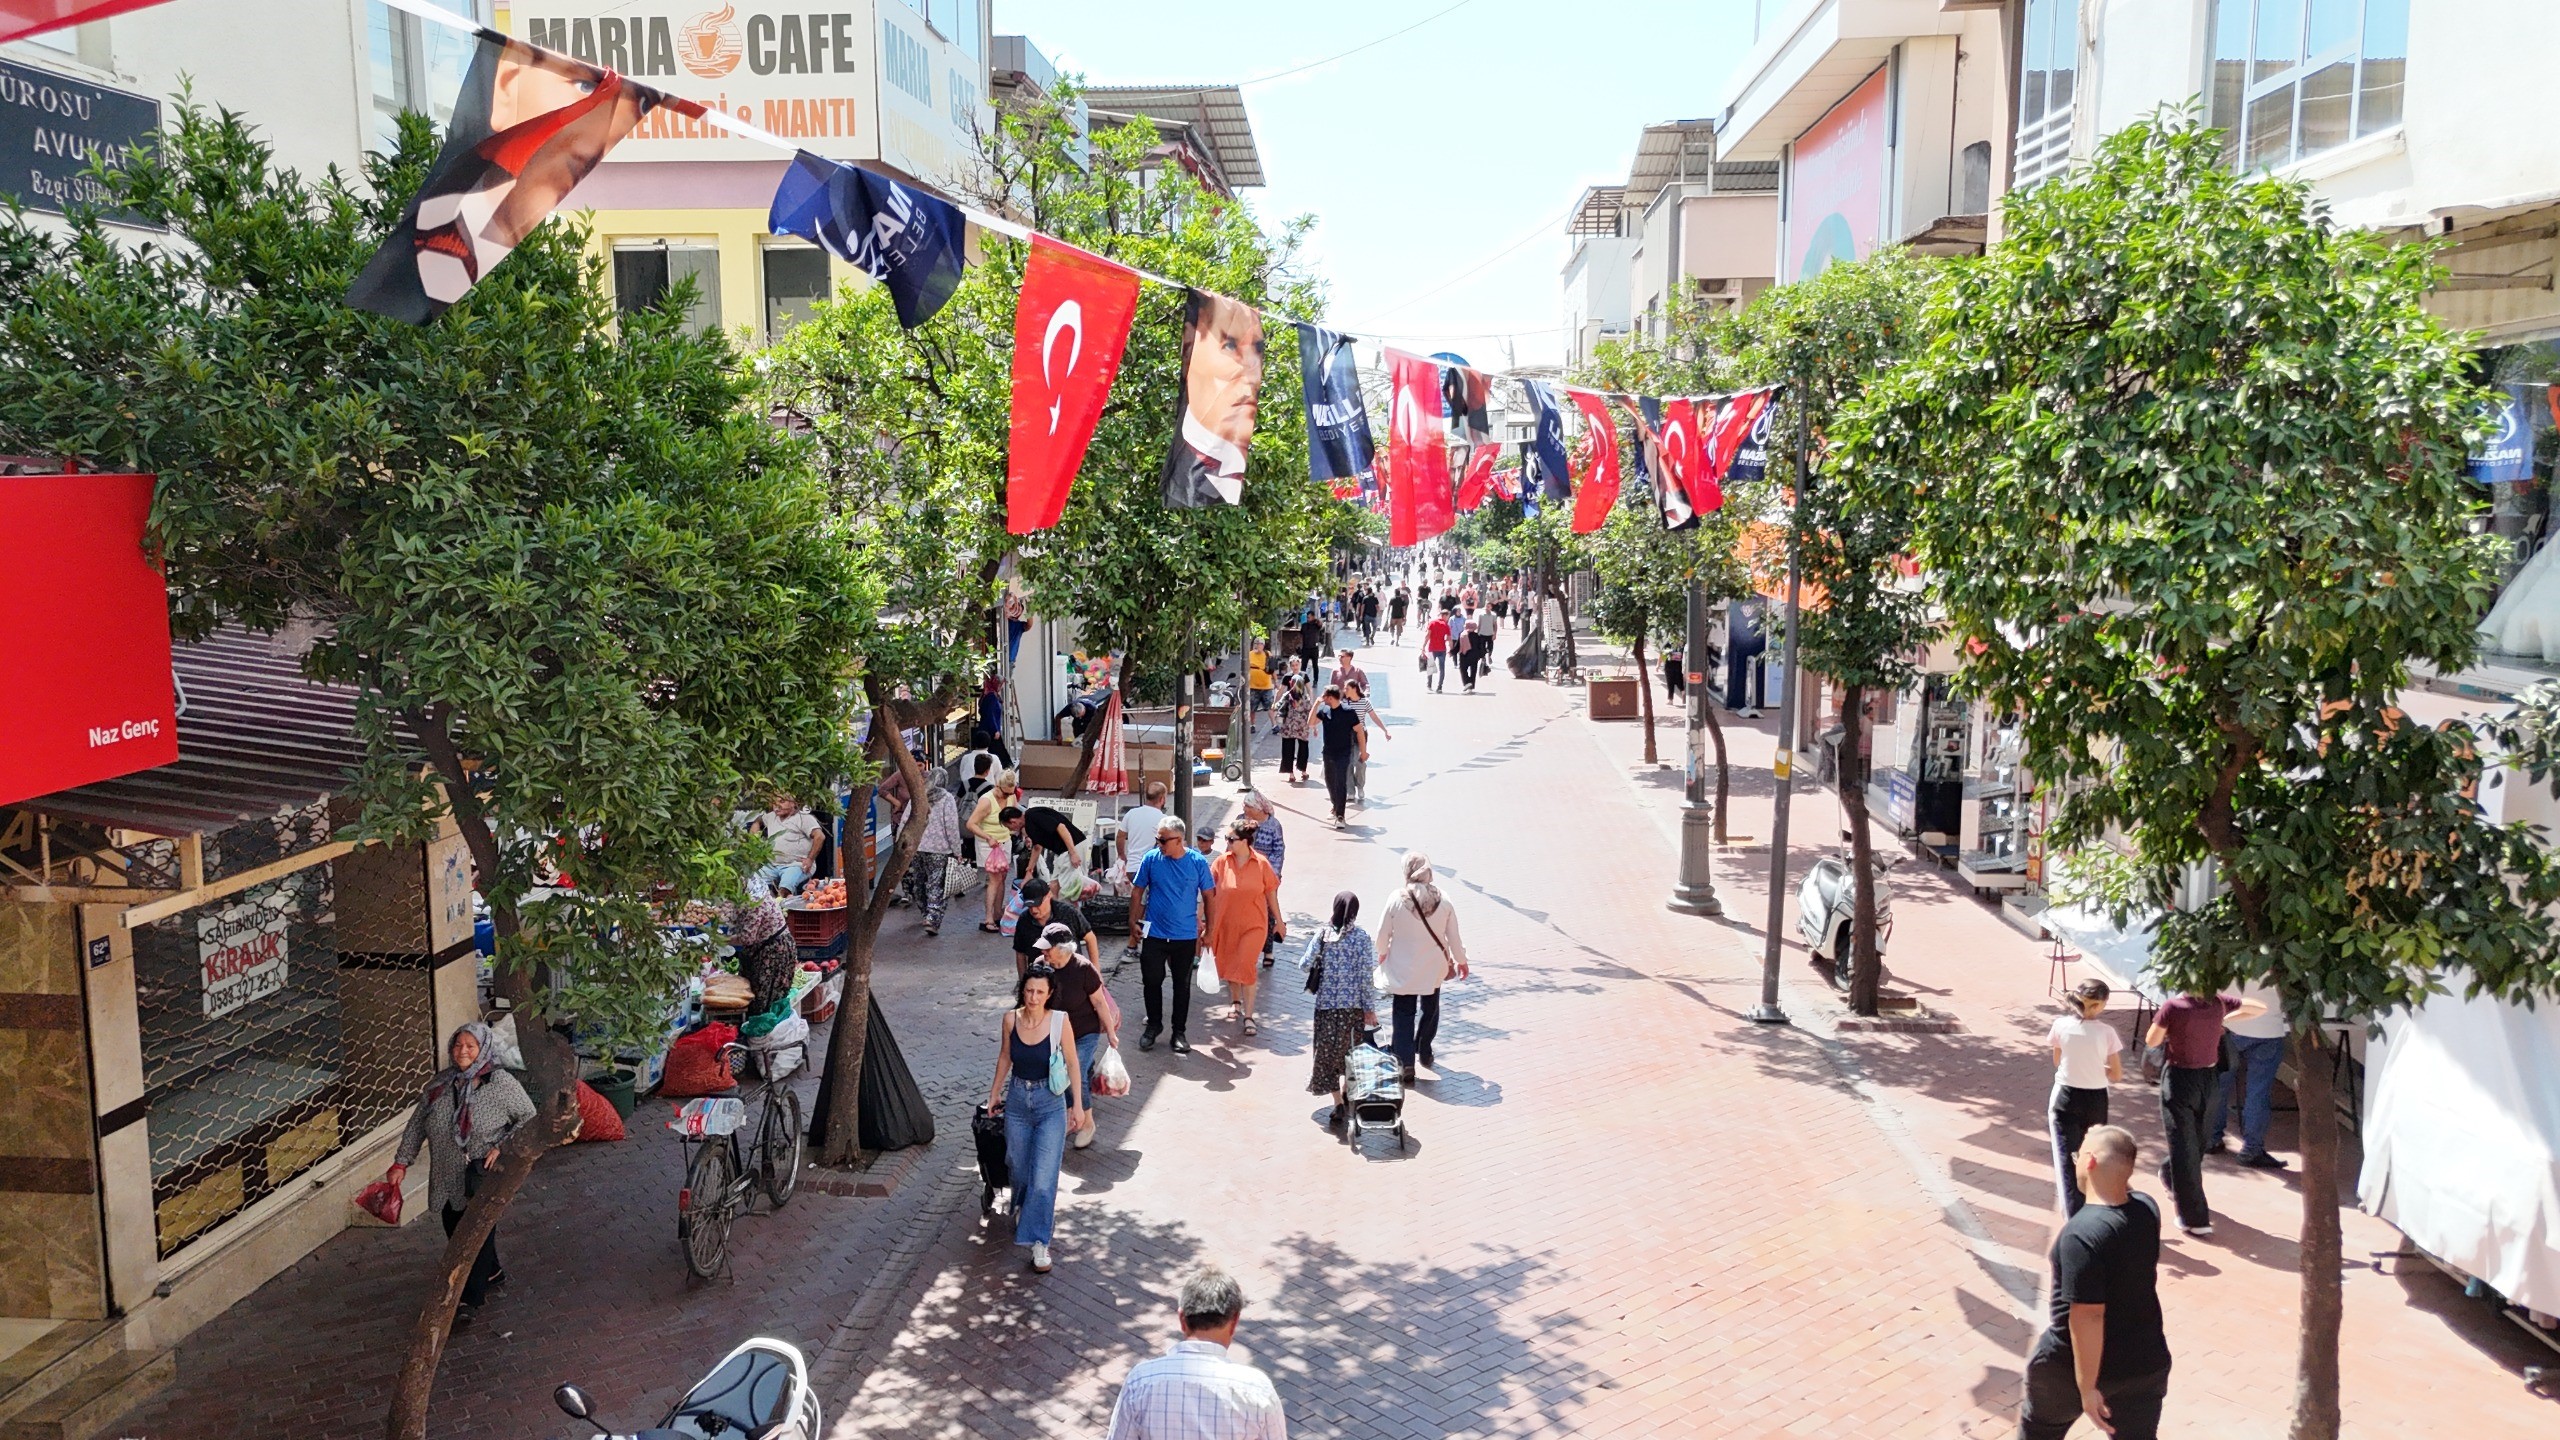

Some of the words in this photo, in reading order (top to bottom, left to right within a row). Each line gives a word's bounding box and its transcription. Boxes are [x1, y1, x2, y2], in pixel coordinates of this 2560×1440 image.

[747, 13, 855, 75] CAFE
[884, 18, 932, 109] MARIA
[627, 92, 728, 140] EKLERİ
[764, 98, 856, 138] MANTI
[34, 126, 129, 171] AVUKAT
[31, 169, 70, 204] Ezgi
[89, 727, 120, 748] Naz
[121, 719, 160, 739] Genç
